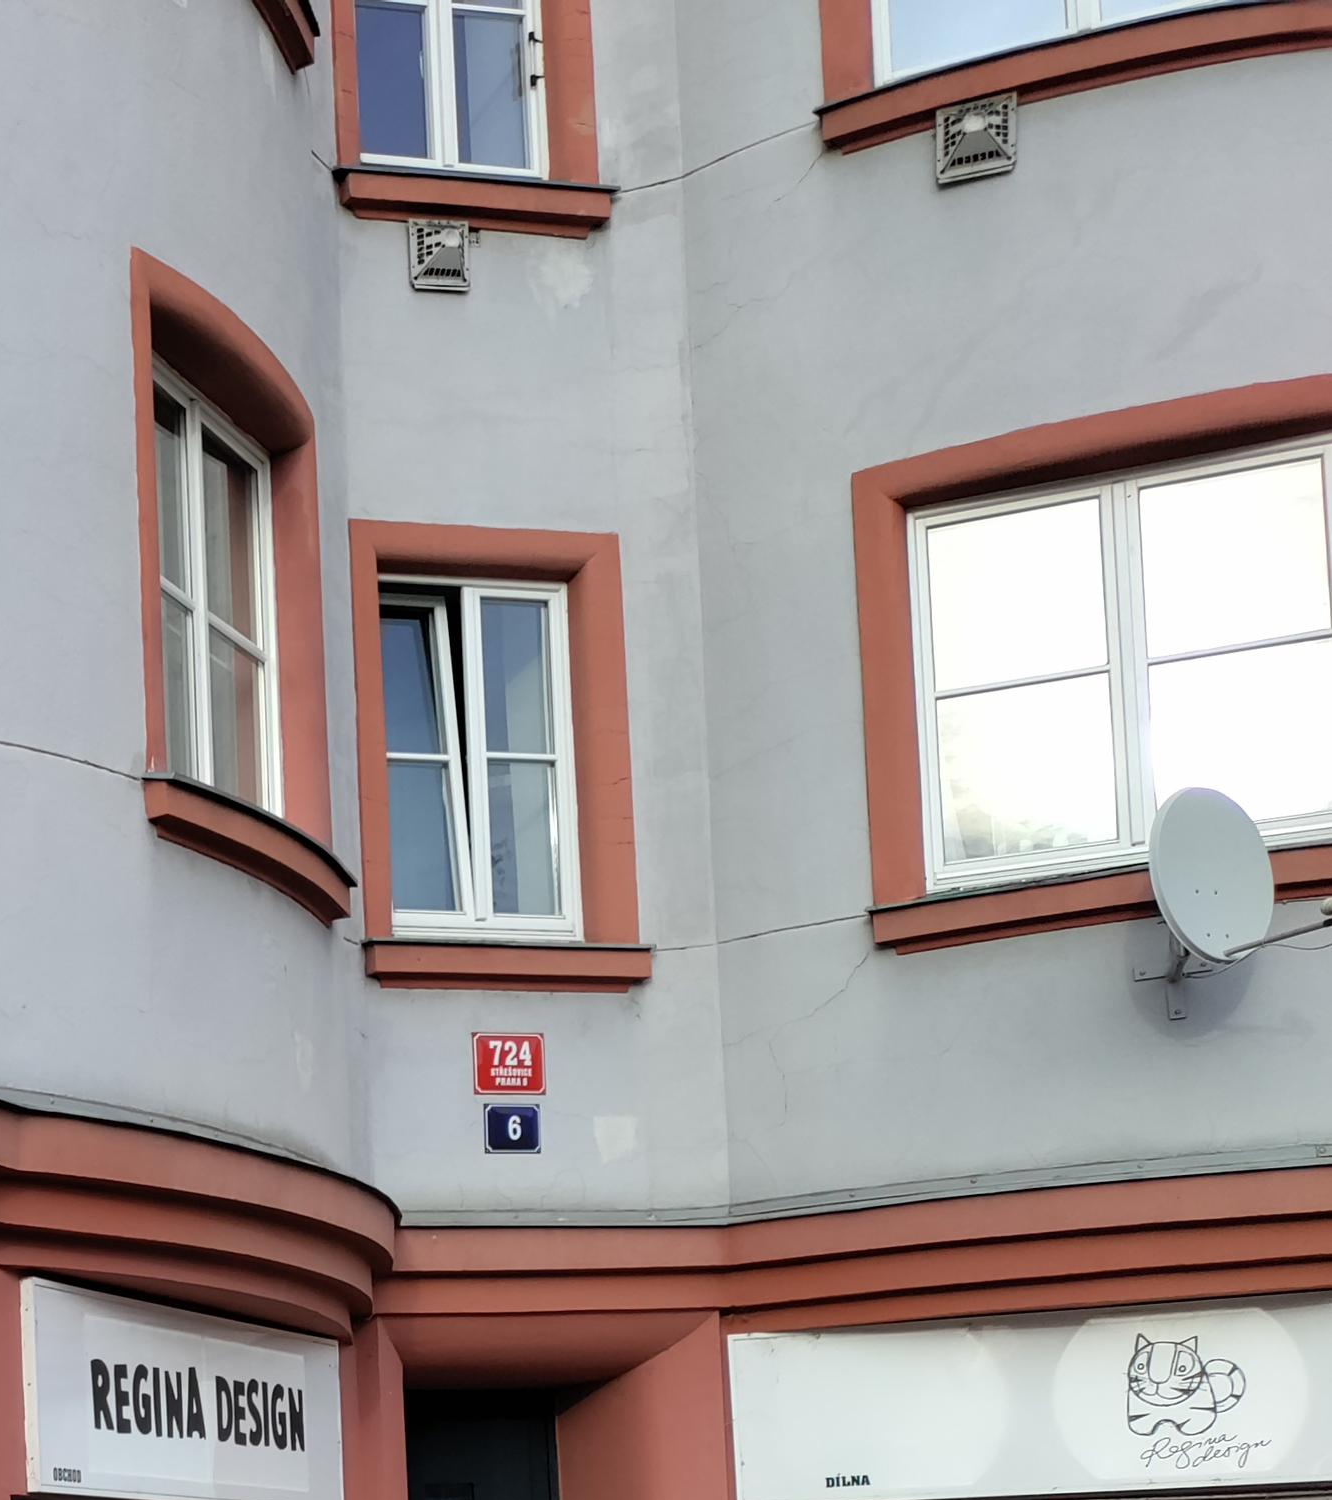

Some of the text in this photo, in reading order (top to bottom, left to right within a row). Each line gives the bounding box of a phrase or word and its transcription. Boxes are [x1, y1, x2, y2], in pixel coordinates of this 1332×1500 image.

[489, 1040, 532, 1066] 724
[495, 1077, 521, 1086] PRAHA
[508, 1115, 522, 1141] 6
[90, 1358, 305, 1452] REGINA DESIGN
[1140, 1433, 1237, 1469] Regina
[1192, 1439, 1272, 1468] design
[53, 1467, 82, 1483] OBCHOD
[825, 1473, 871, 1488] DÍLNA
